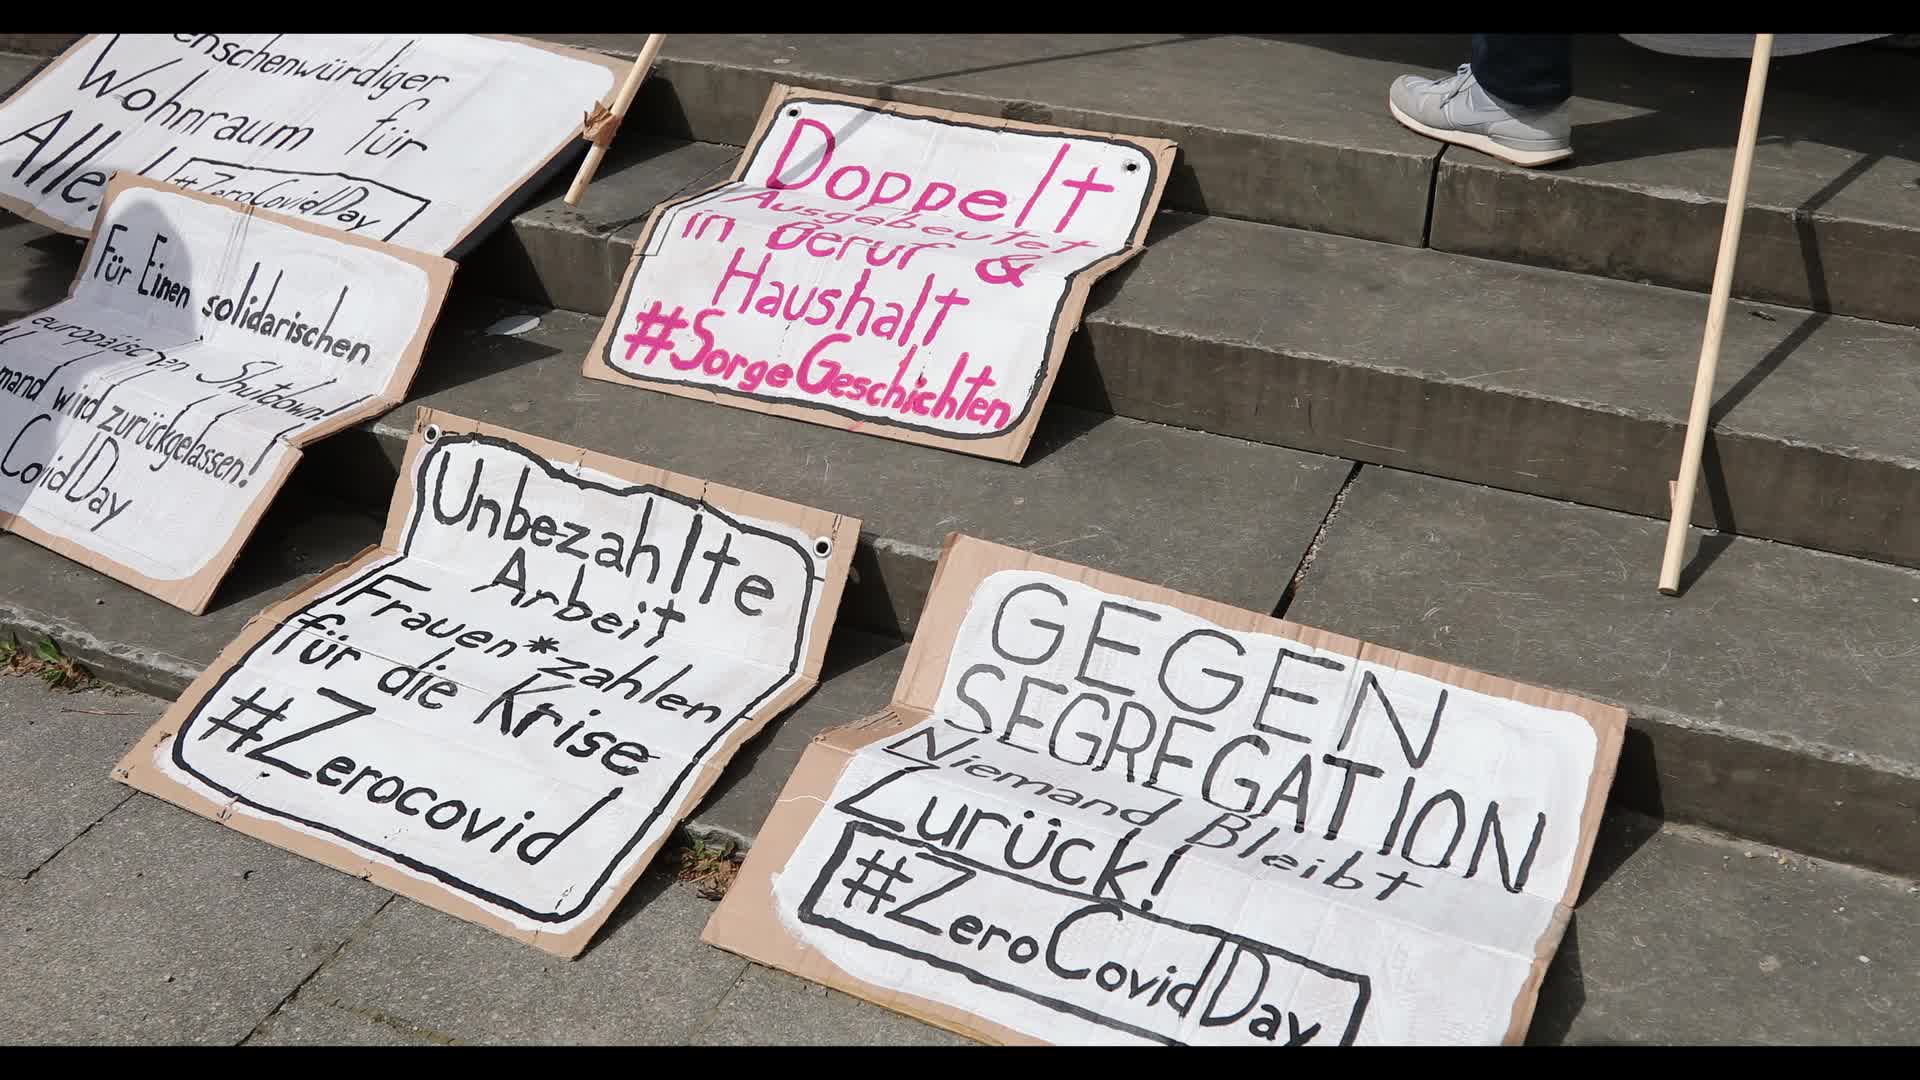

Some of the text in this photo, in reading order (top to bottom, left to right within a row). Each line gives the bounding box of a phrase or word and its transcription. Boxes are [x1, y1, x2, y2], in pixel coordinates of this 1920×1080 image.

[78, 33, 428, 158] Wohnraum für
[725, 190, 1099, 253] Ausgebeutet
[766, 118, 1114, 233] Doppelt
[93, 224, 371, 365] Für Einen solidarischen
[681, 210, 1041, 288] in Beruf &
[712, 248, 969, 347] Haushalt
[52, 369, 155, 423] wird
[196, 360, 373, 421] Shutdown!
[624, 301, 1012, 429] #SorgeGeschichten
[0, 413, 132, 532] CovidDay
[97, 394, 305, 488] zurückgelassen!
[432, 451, 775, 616] Unbezahlte
[472, 548, 685, 647] Arbeit
[272, 612, 659, 777] für die Krise
[991, 583, 1447, 769] GEGEN
[199, 688, 624, 867] #Zerocovid
[836, 767, 1192, 910] Zurück!
[883, 725, 1422, 902] Niemand Bleibt
[944, 664, 1546, 894] SEGREGATION
[843, 848, 1321, 1046] #ZeroCovidDay
